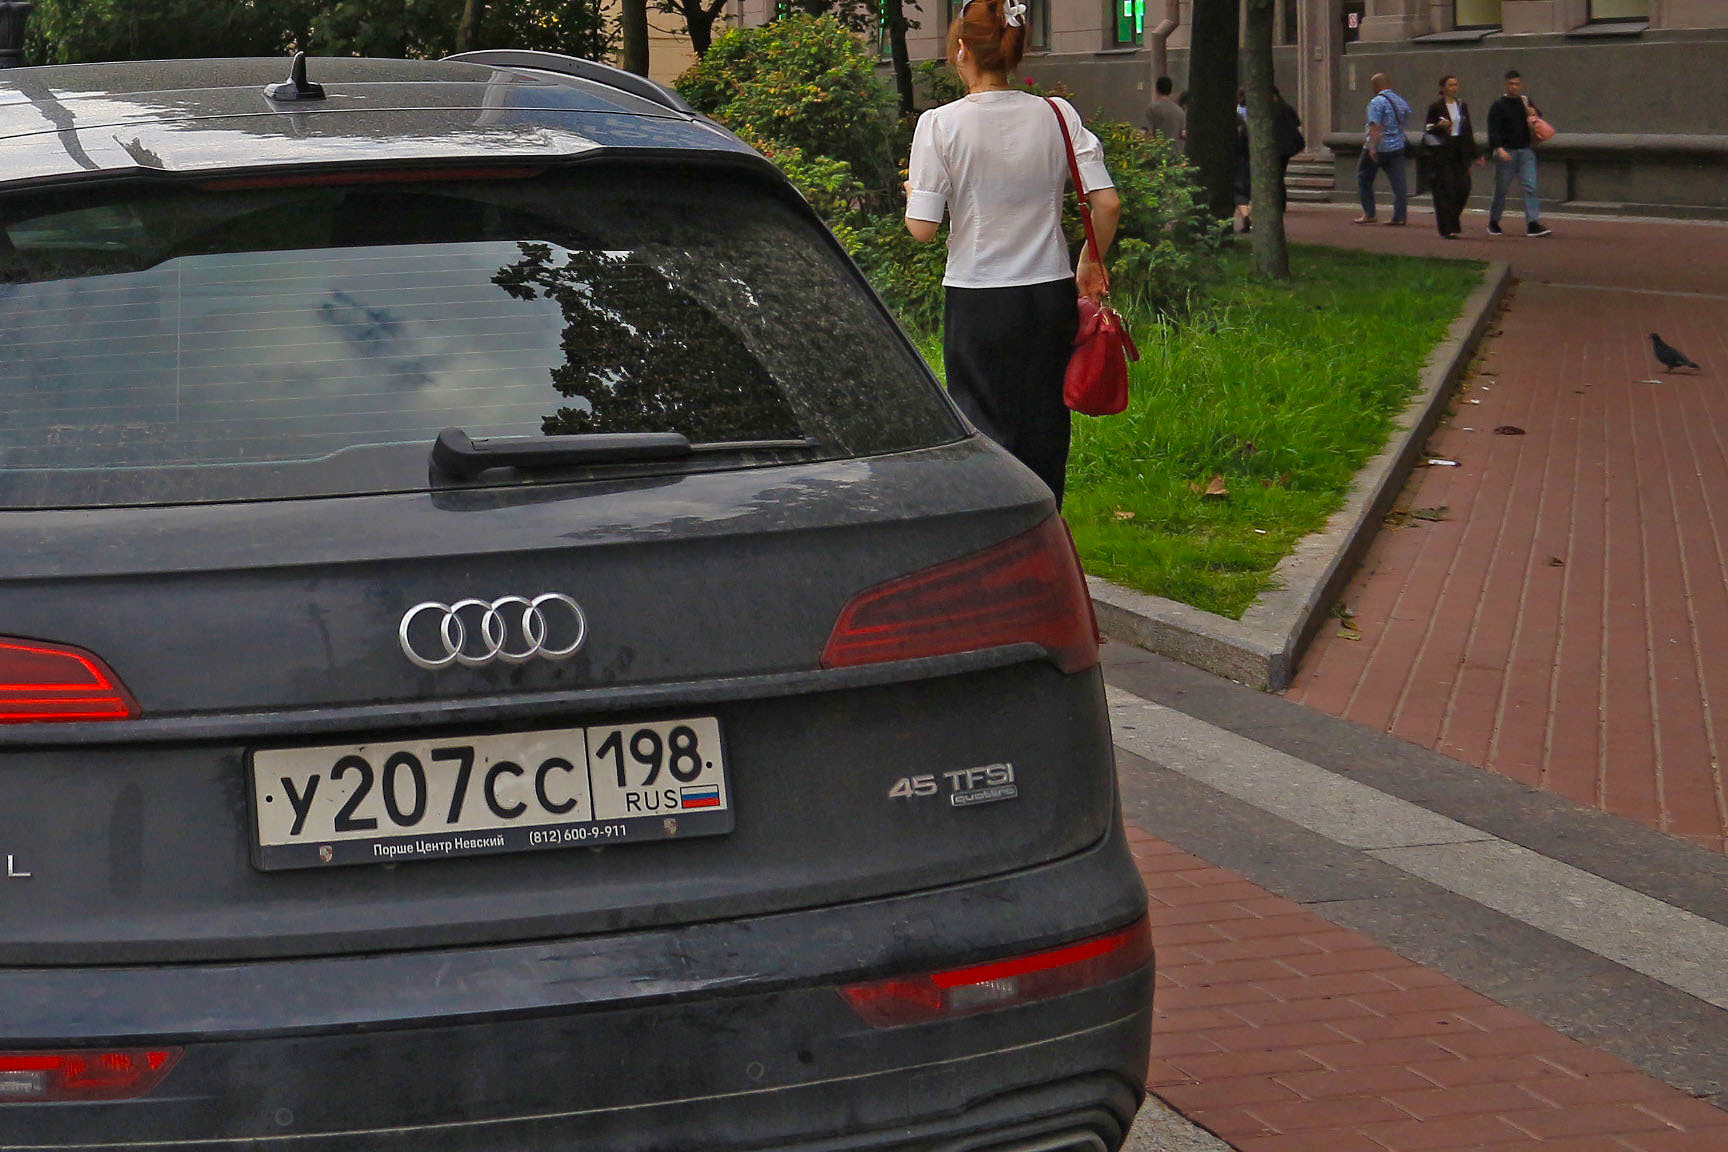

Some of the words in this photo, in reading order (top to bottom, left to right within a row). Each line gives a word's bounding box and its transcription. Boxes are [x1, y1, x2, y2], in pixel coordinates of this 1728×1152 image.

[595, 725, 703, 788] 198
[888, 774, 938, 798] 45
[943, 762, 1014, 790] TFSI
[626, 789, 679, 813] RUS
[373, 842, 414, 857] Порше
[415, 838, 453, 853] Центр
[454, 834, 505, 849] Невский
[528, 827, 562, 846] (812)
[563, 824, 627, 842] 600-9-911
[7, 854, 31, 877] L
